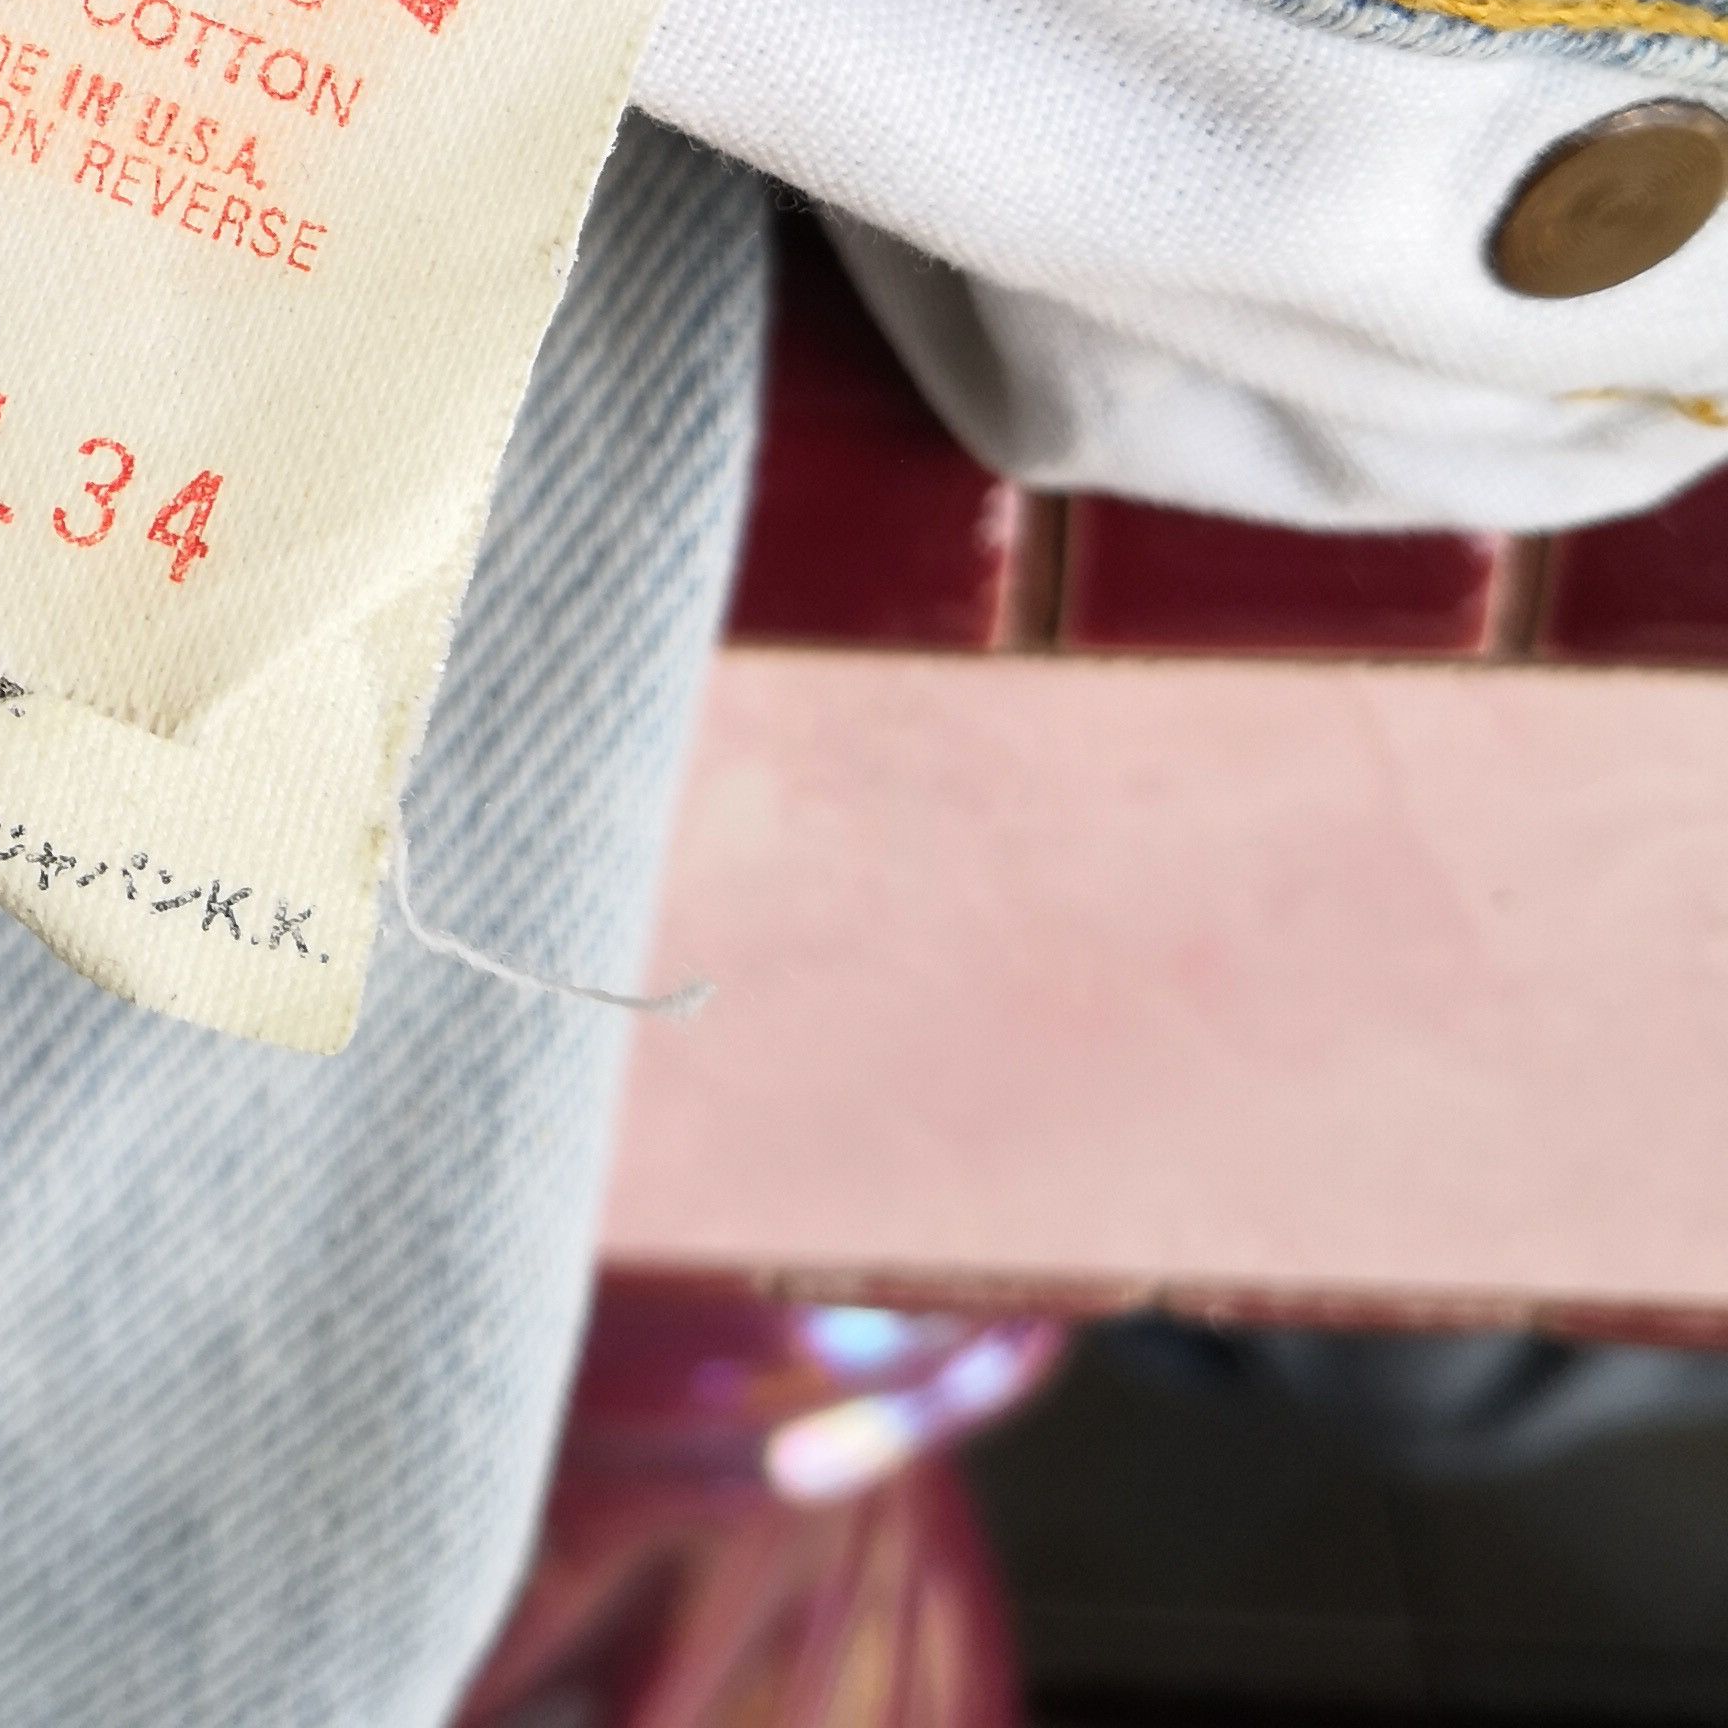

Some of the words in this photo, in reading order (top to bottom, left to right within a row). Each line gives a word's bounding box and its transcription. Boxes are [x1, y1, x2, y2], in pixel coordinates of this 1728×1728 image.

[59, 64, 124, 127] IN
[140, 96, 267, 191] U.S.A.
[74, 139, 329, 273] REVERSE
